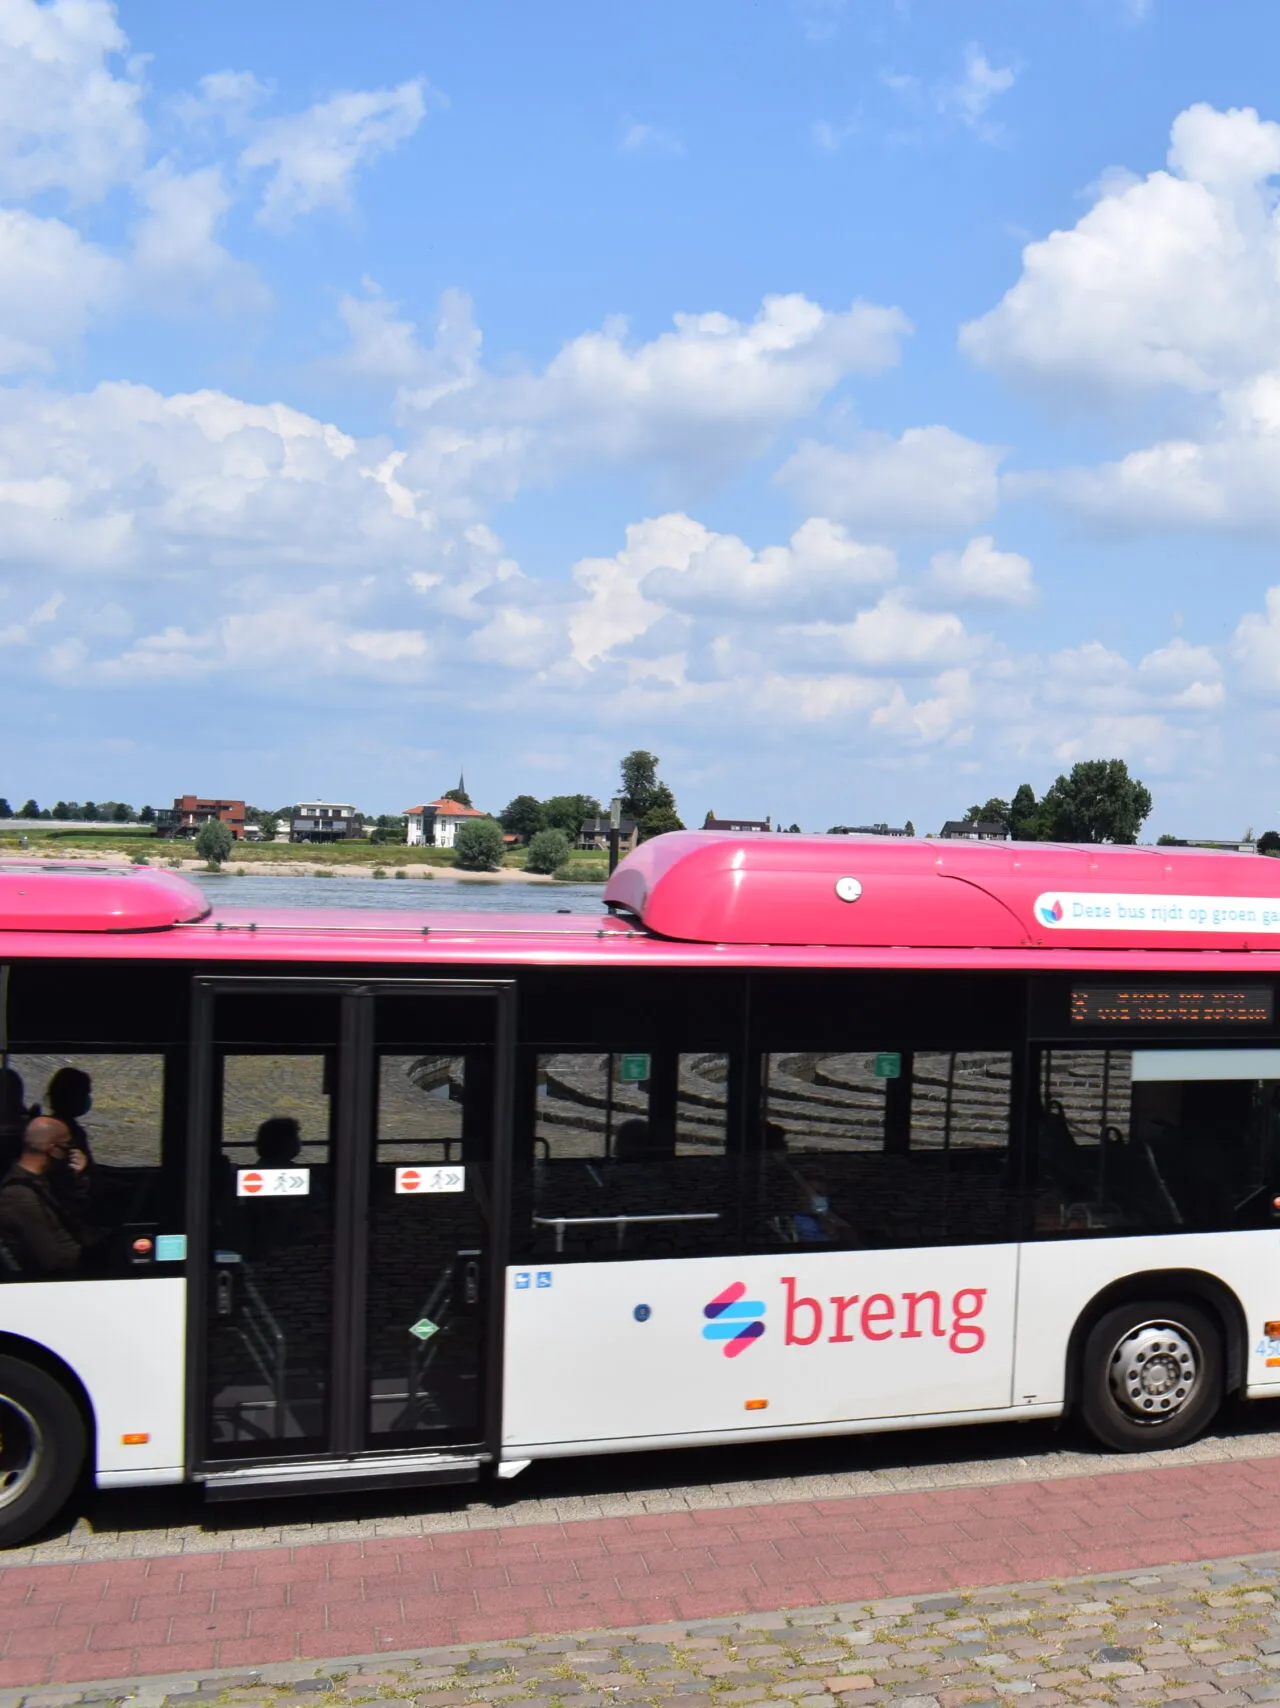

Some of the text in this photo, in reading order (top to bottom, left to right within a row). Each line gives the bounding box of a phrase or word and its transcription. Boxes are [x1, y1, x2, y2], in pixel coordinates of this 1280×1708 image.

[1072, 902, 1112, 918] Deze
[1117, 903, 1146, 920] bus
[1151, 904, 1183, 923] rijdt
[1189, 909, 1207, 924] op
[1212, 908, 1257, 925] groen
[780, 1276, 988, 1354] breng
